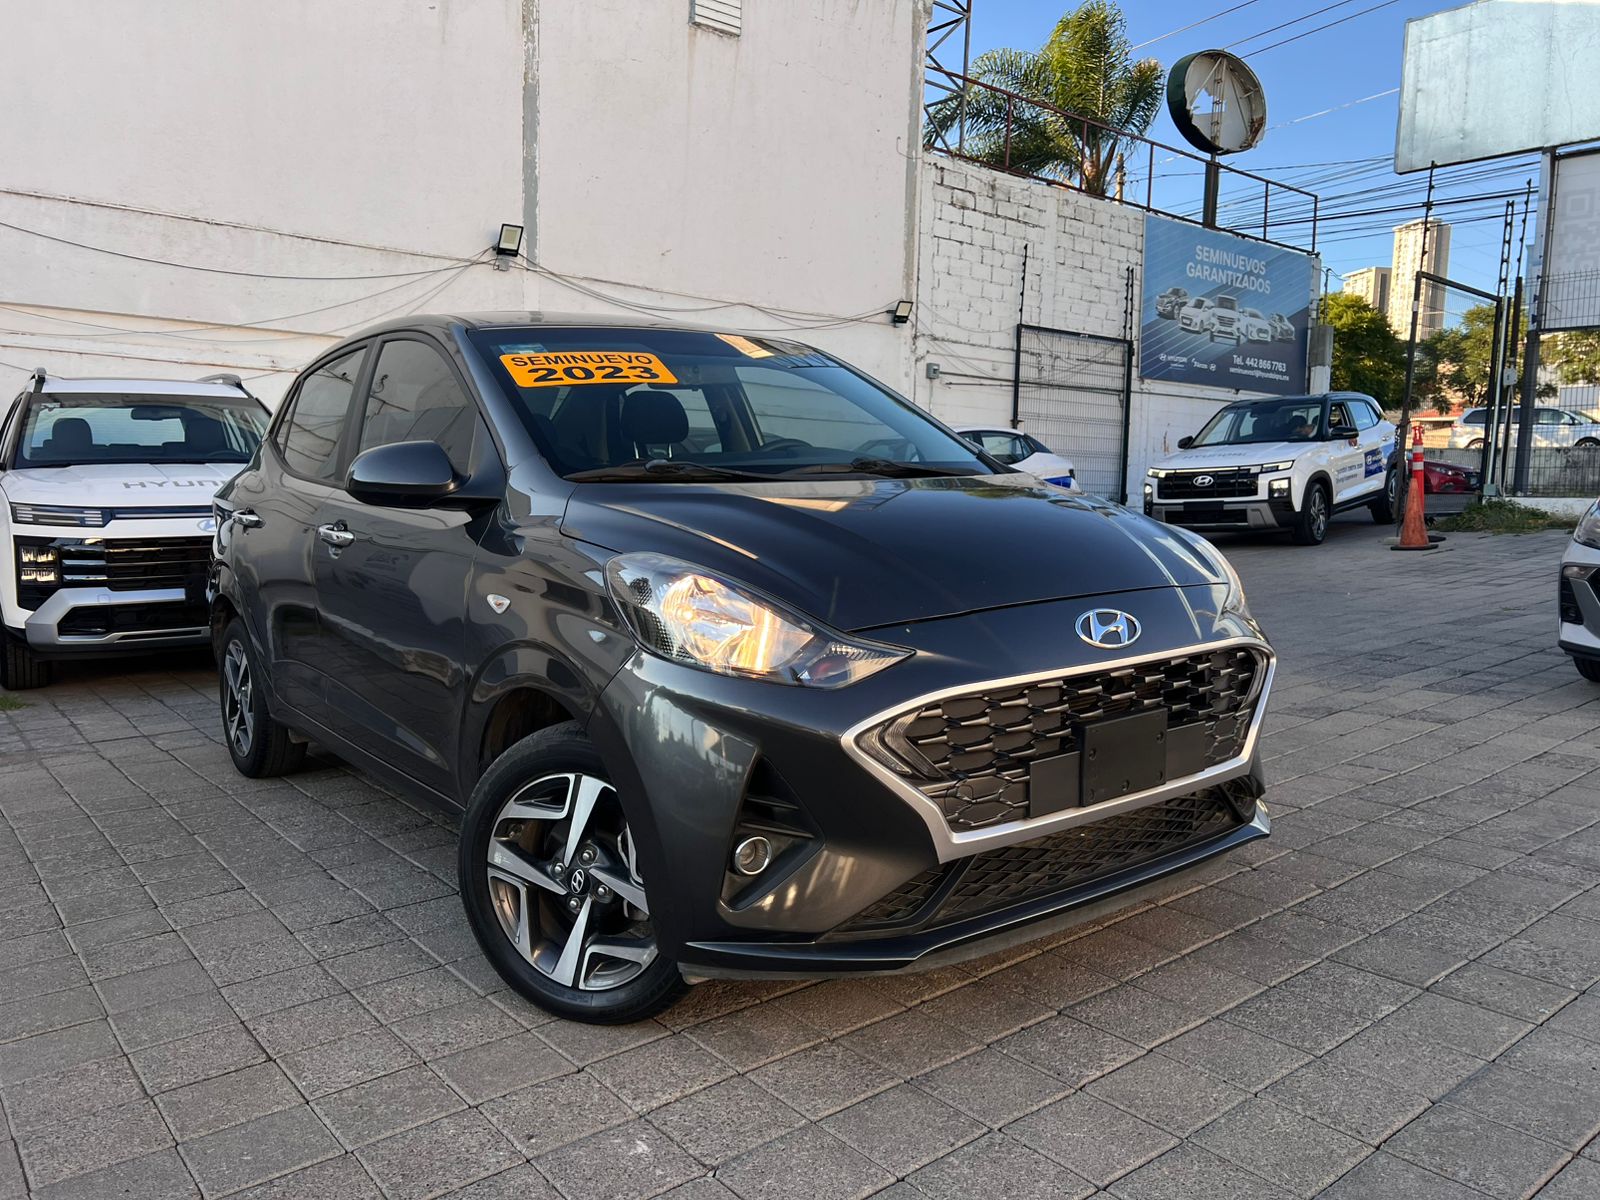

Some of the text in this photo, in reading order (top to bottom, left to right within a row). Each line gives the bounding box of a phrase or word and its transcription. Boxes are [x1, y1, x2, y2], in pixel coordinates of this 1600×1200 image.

[1195, 245, 1266, 275] SEMINUEVOS
[1186, 262, 1271, 294] GARANTIZADOS
[511, 354, 653, 366] SEMINUEVO
[1245, 357, 1258, 368] 442
[528, 365, 660, 382] 2023
